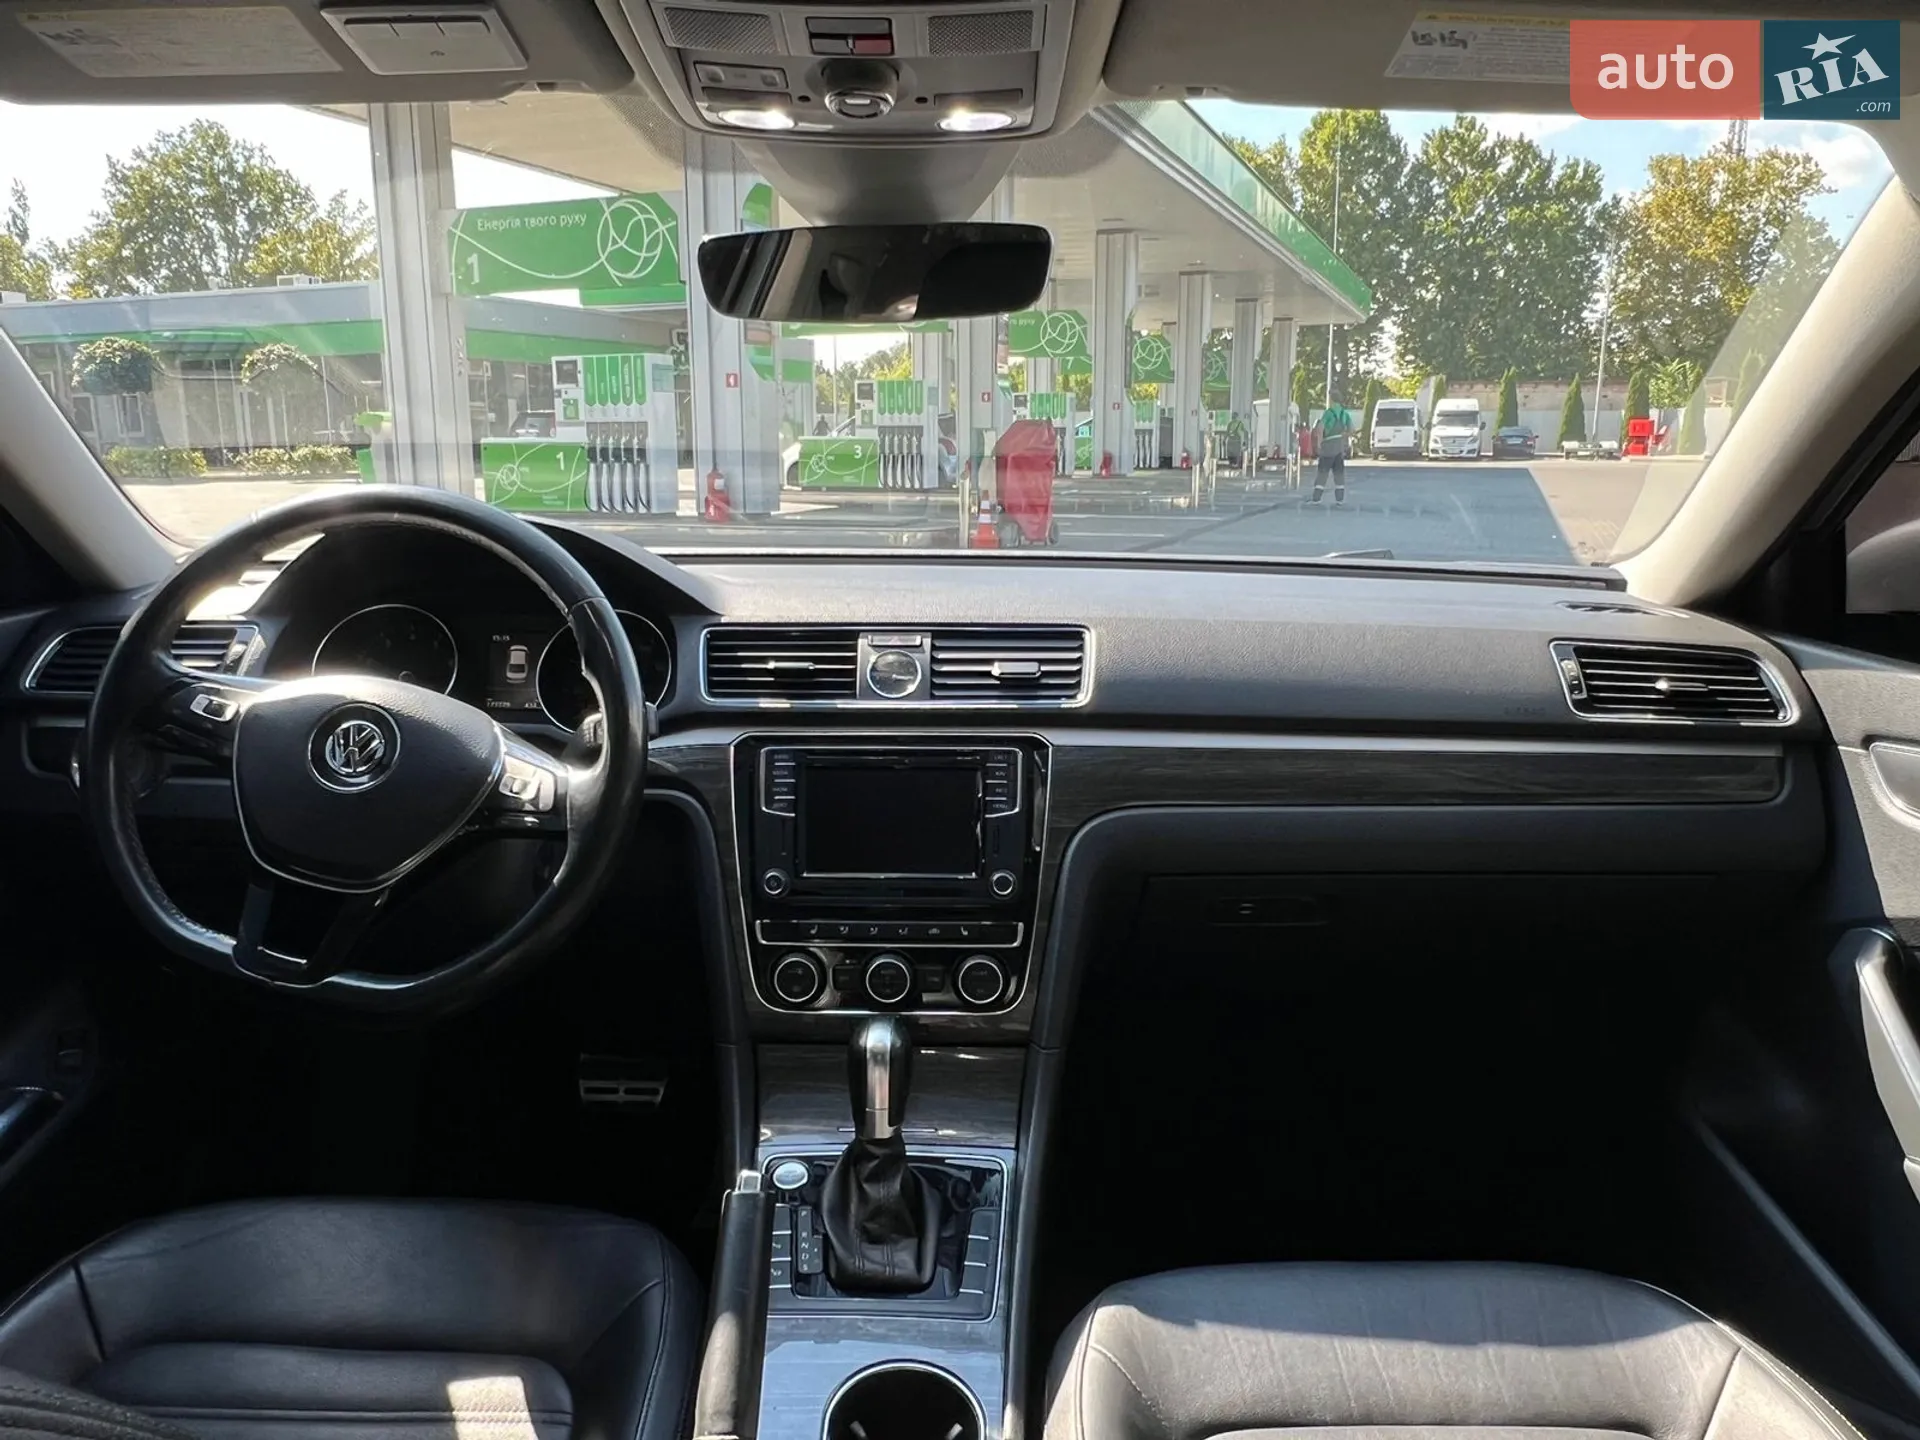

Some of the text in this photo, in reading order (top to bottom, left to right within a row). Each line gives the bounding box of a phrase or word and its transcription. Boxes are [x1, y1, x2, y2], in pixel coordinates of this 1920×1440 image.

[477, 213, 587, 232] Енергія твого руху
[467, 253, 481, 285] 1
[556, 451, 565, 470] 1
[854, 445, 862, 459] 3
